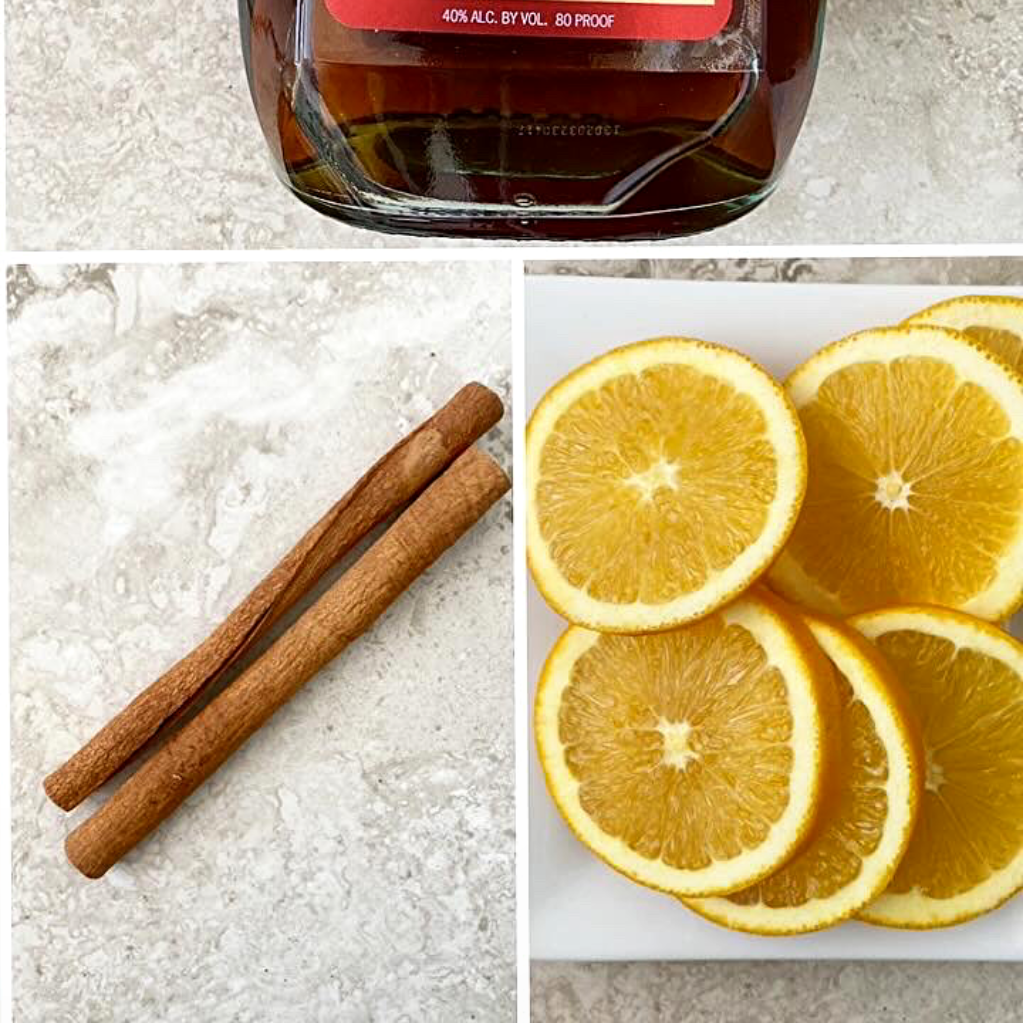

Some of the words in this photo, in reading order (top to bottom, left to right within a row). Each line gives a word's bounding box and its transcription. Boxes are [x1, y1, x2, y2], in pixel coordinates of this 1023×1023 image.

[442, 9, 468, 23] 40%
[470, 10, 498, 24] ALC.
[501, 11, 518, 25] BY
[520, 12, 548, 26] VOL.
[555, 13, 572, 27] 80
[575, 14, 614, 28] PROOF
